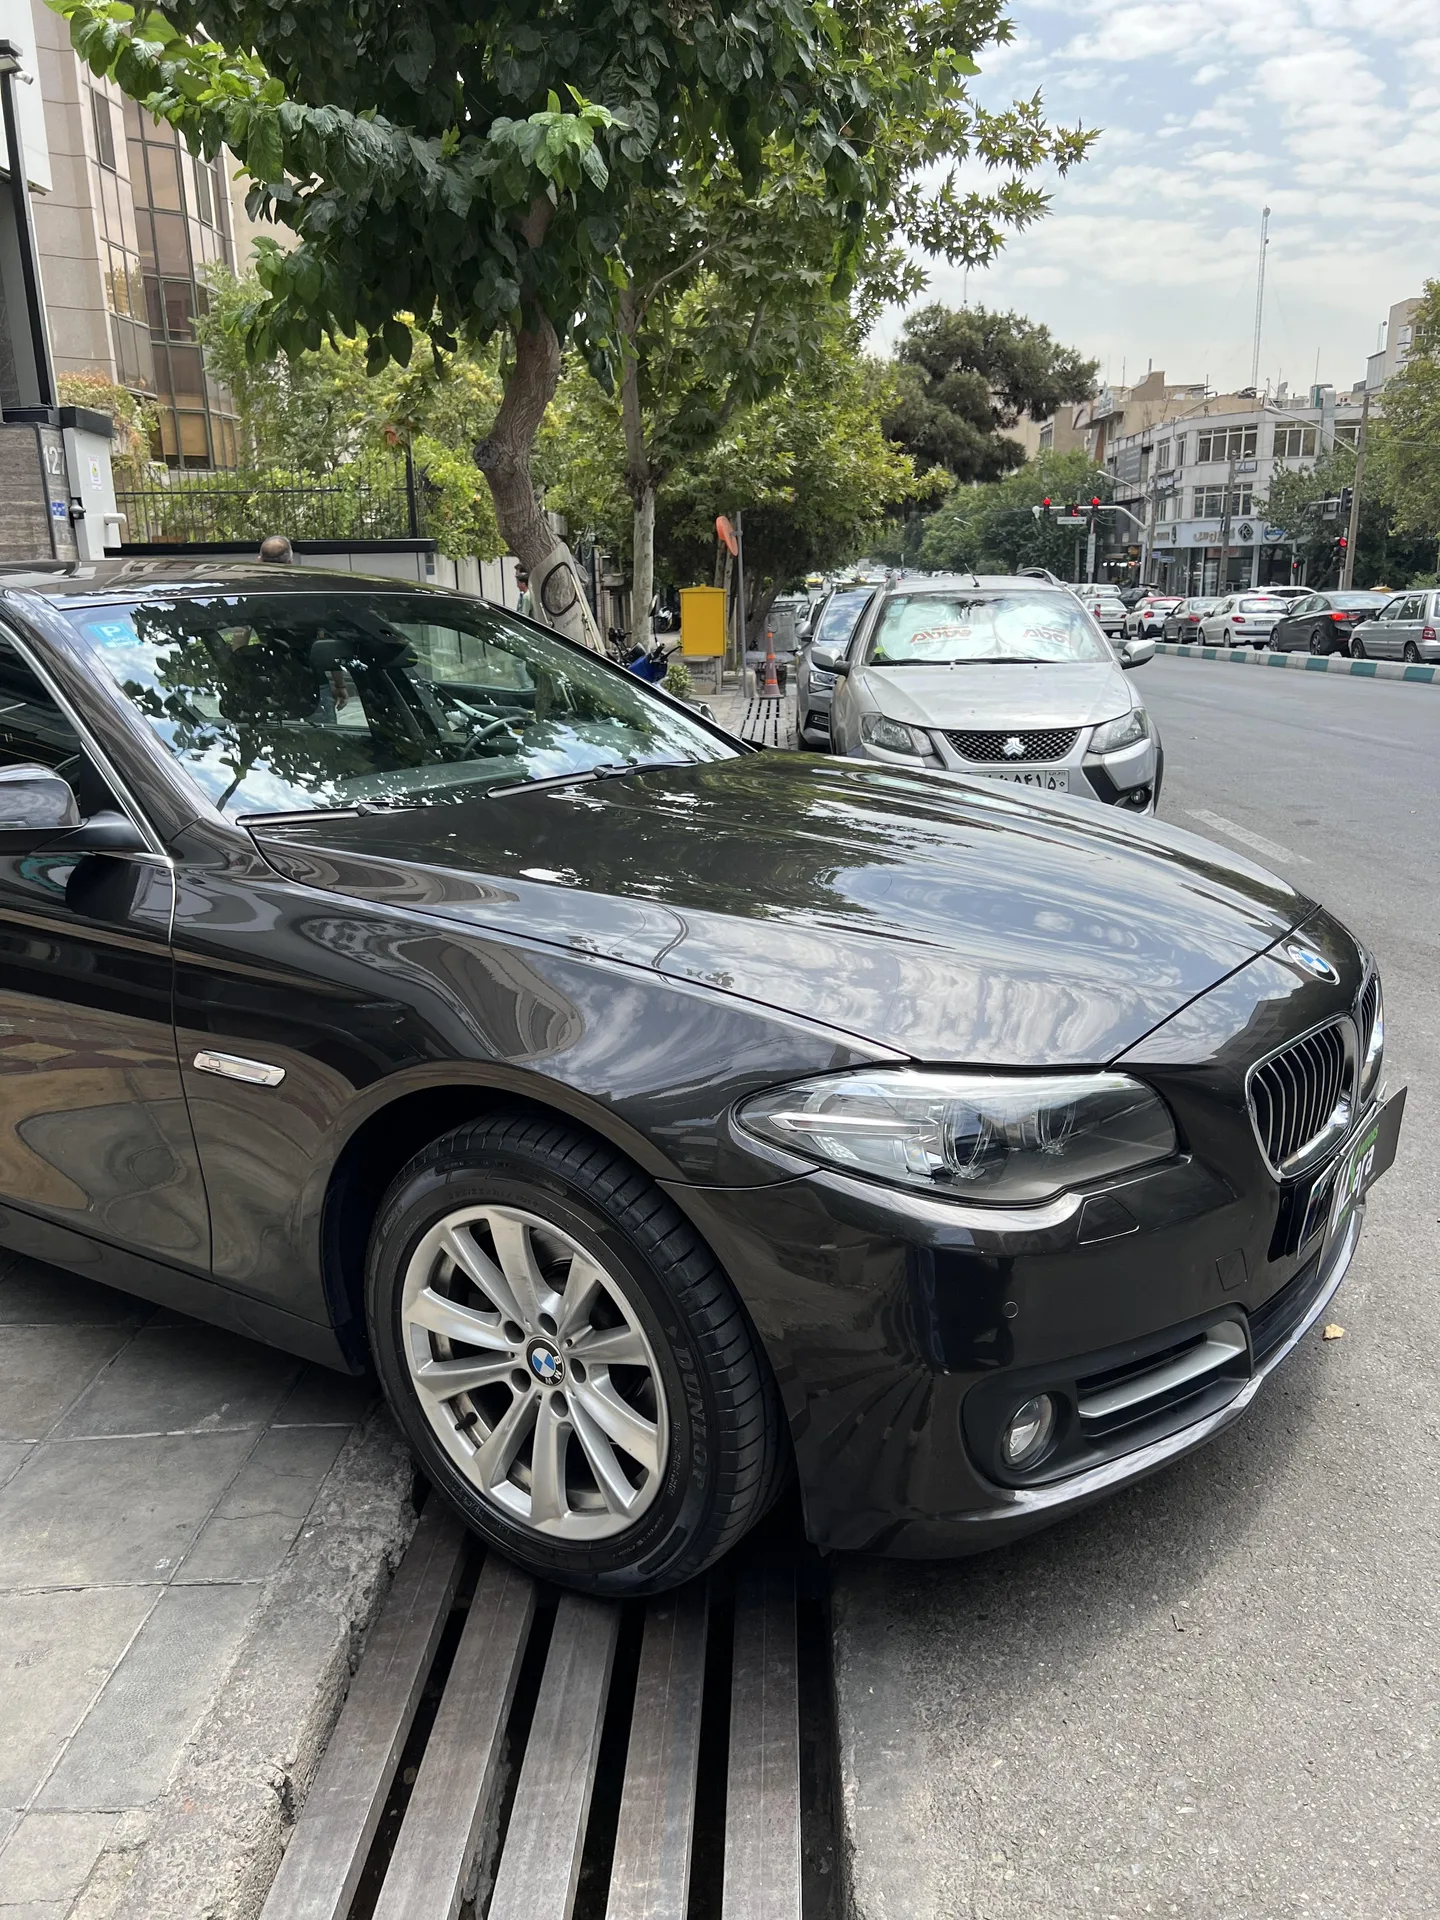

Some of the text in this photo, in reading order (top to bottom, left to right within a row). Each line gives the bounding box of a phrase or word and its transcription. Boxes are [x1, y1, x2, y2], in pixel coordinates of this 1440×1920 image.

[43, 445, 65, 475] 127
[545, 1355, 562, 1385] BMW
[672, 1345, 708, 1490] DUNLOP
